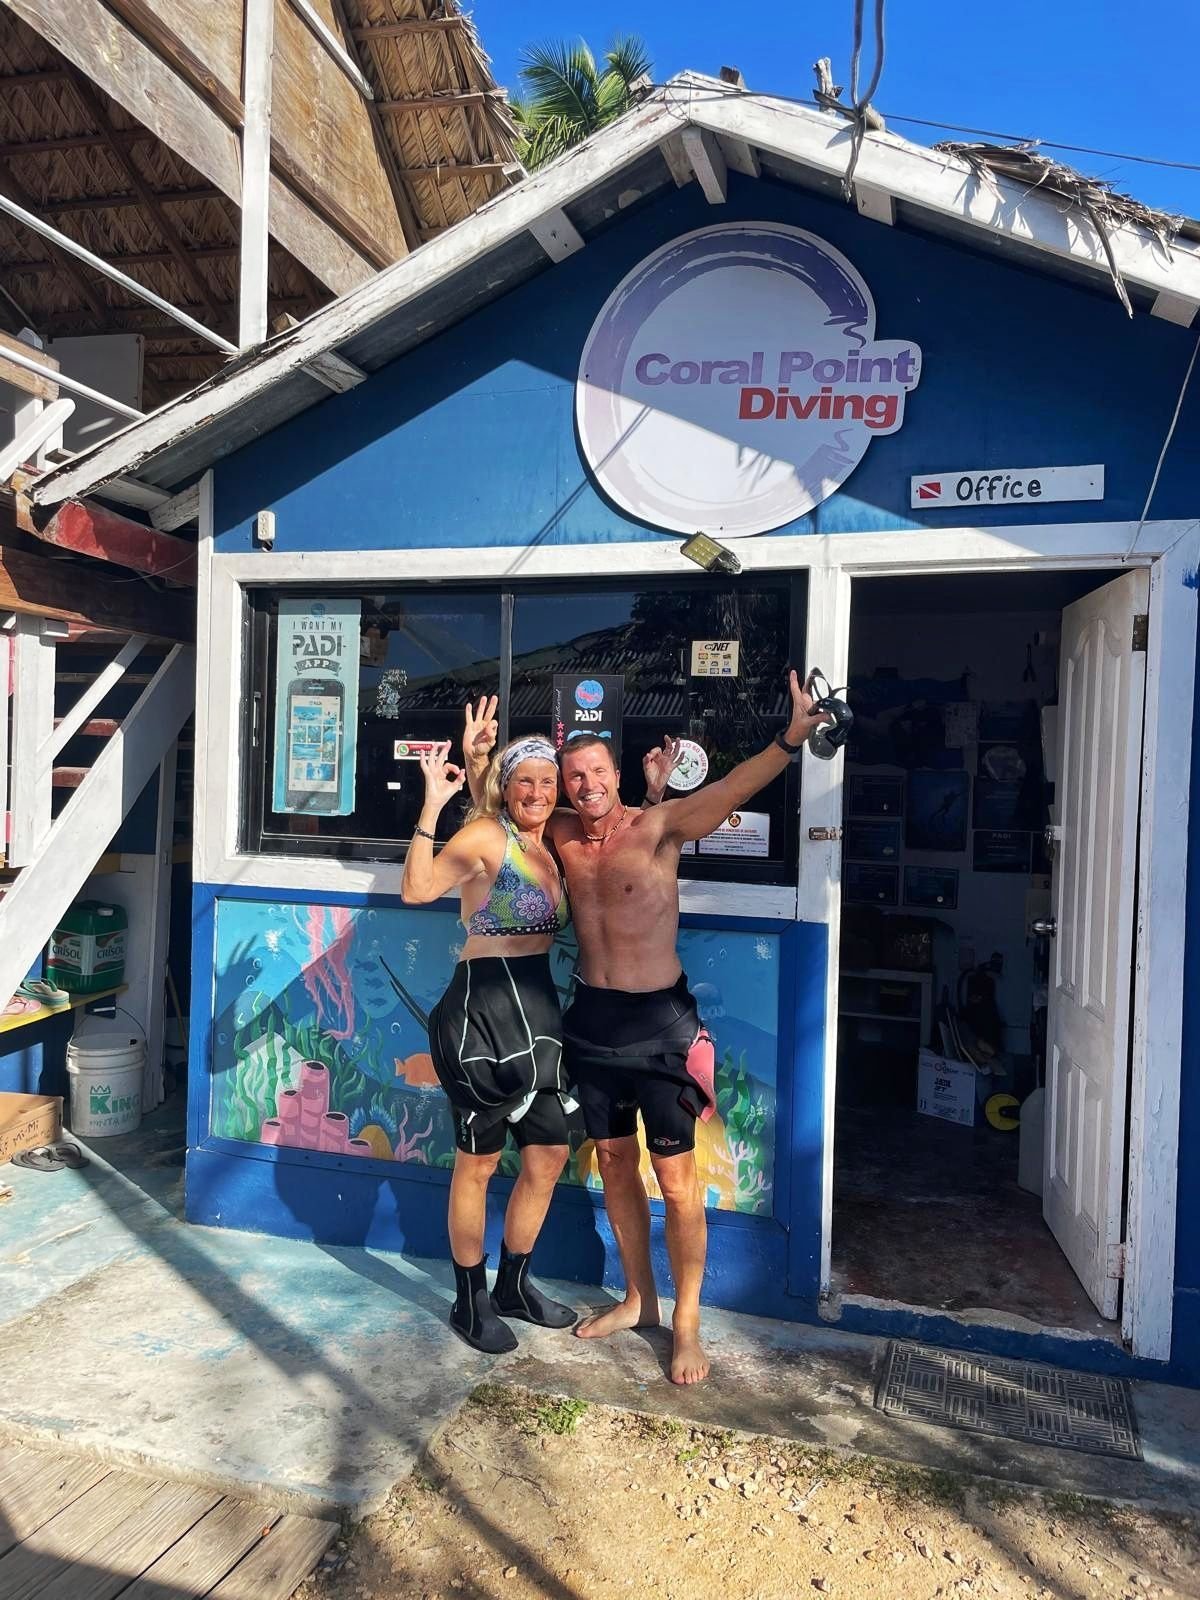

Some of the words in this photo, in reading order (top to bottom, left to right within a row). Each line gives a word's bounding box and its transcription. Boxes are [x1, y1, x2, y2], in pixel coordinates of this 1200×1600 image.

[635, 352, 763, 385] Coral
[778, 348, 917, 385] Point
[738, 386, 899, 429] Diving
[956, 475, 1042, 501] Office
[301, 621, 326, 630] WANT
[330, 621, 343, 630] MY
[292, 634, 343, 657] PADI
[304, 659, 330, 668] APP
[575, 709, 604, 722] PADI
